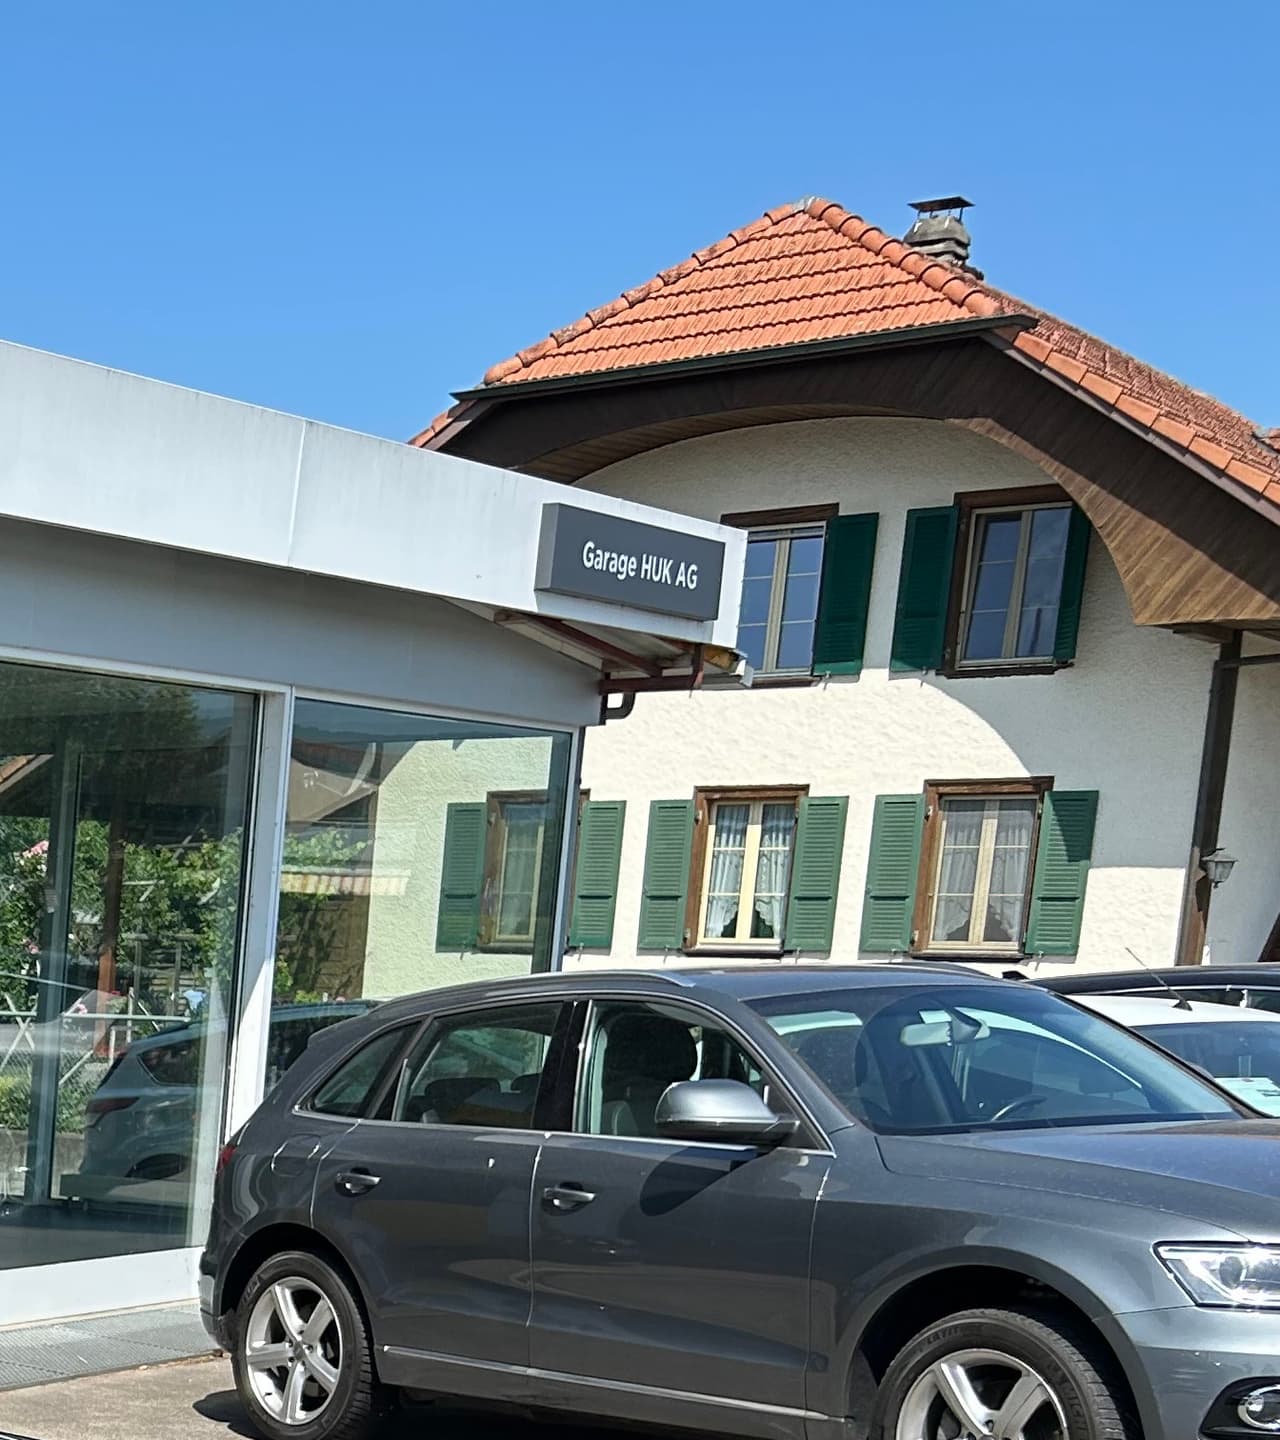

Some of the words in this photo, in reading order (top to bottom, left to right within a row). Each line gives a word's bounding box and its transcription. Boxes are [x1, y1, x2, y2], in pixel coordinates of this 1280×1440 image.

[582, 540, 638, 580] Garage
[640, 553, 673, 585] HUK
[675, 561, 698, 590] AG
